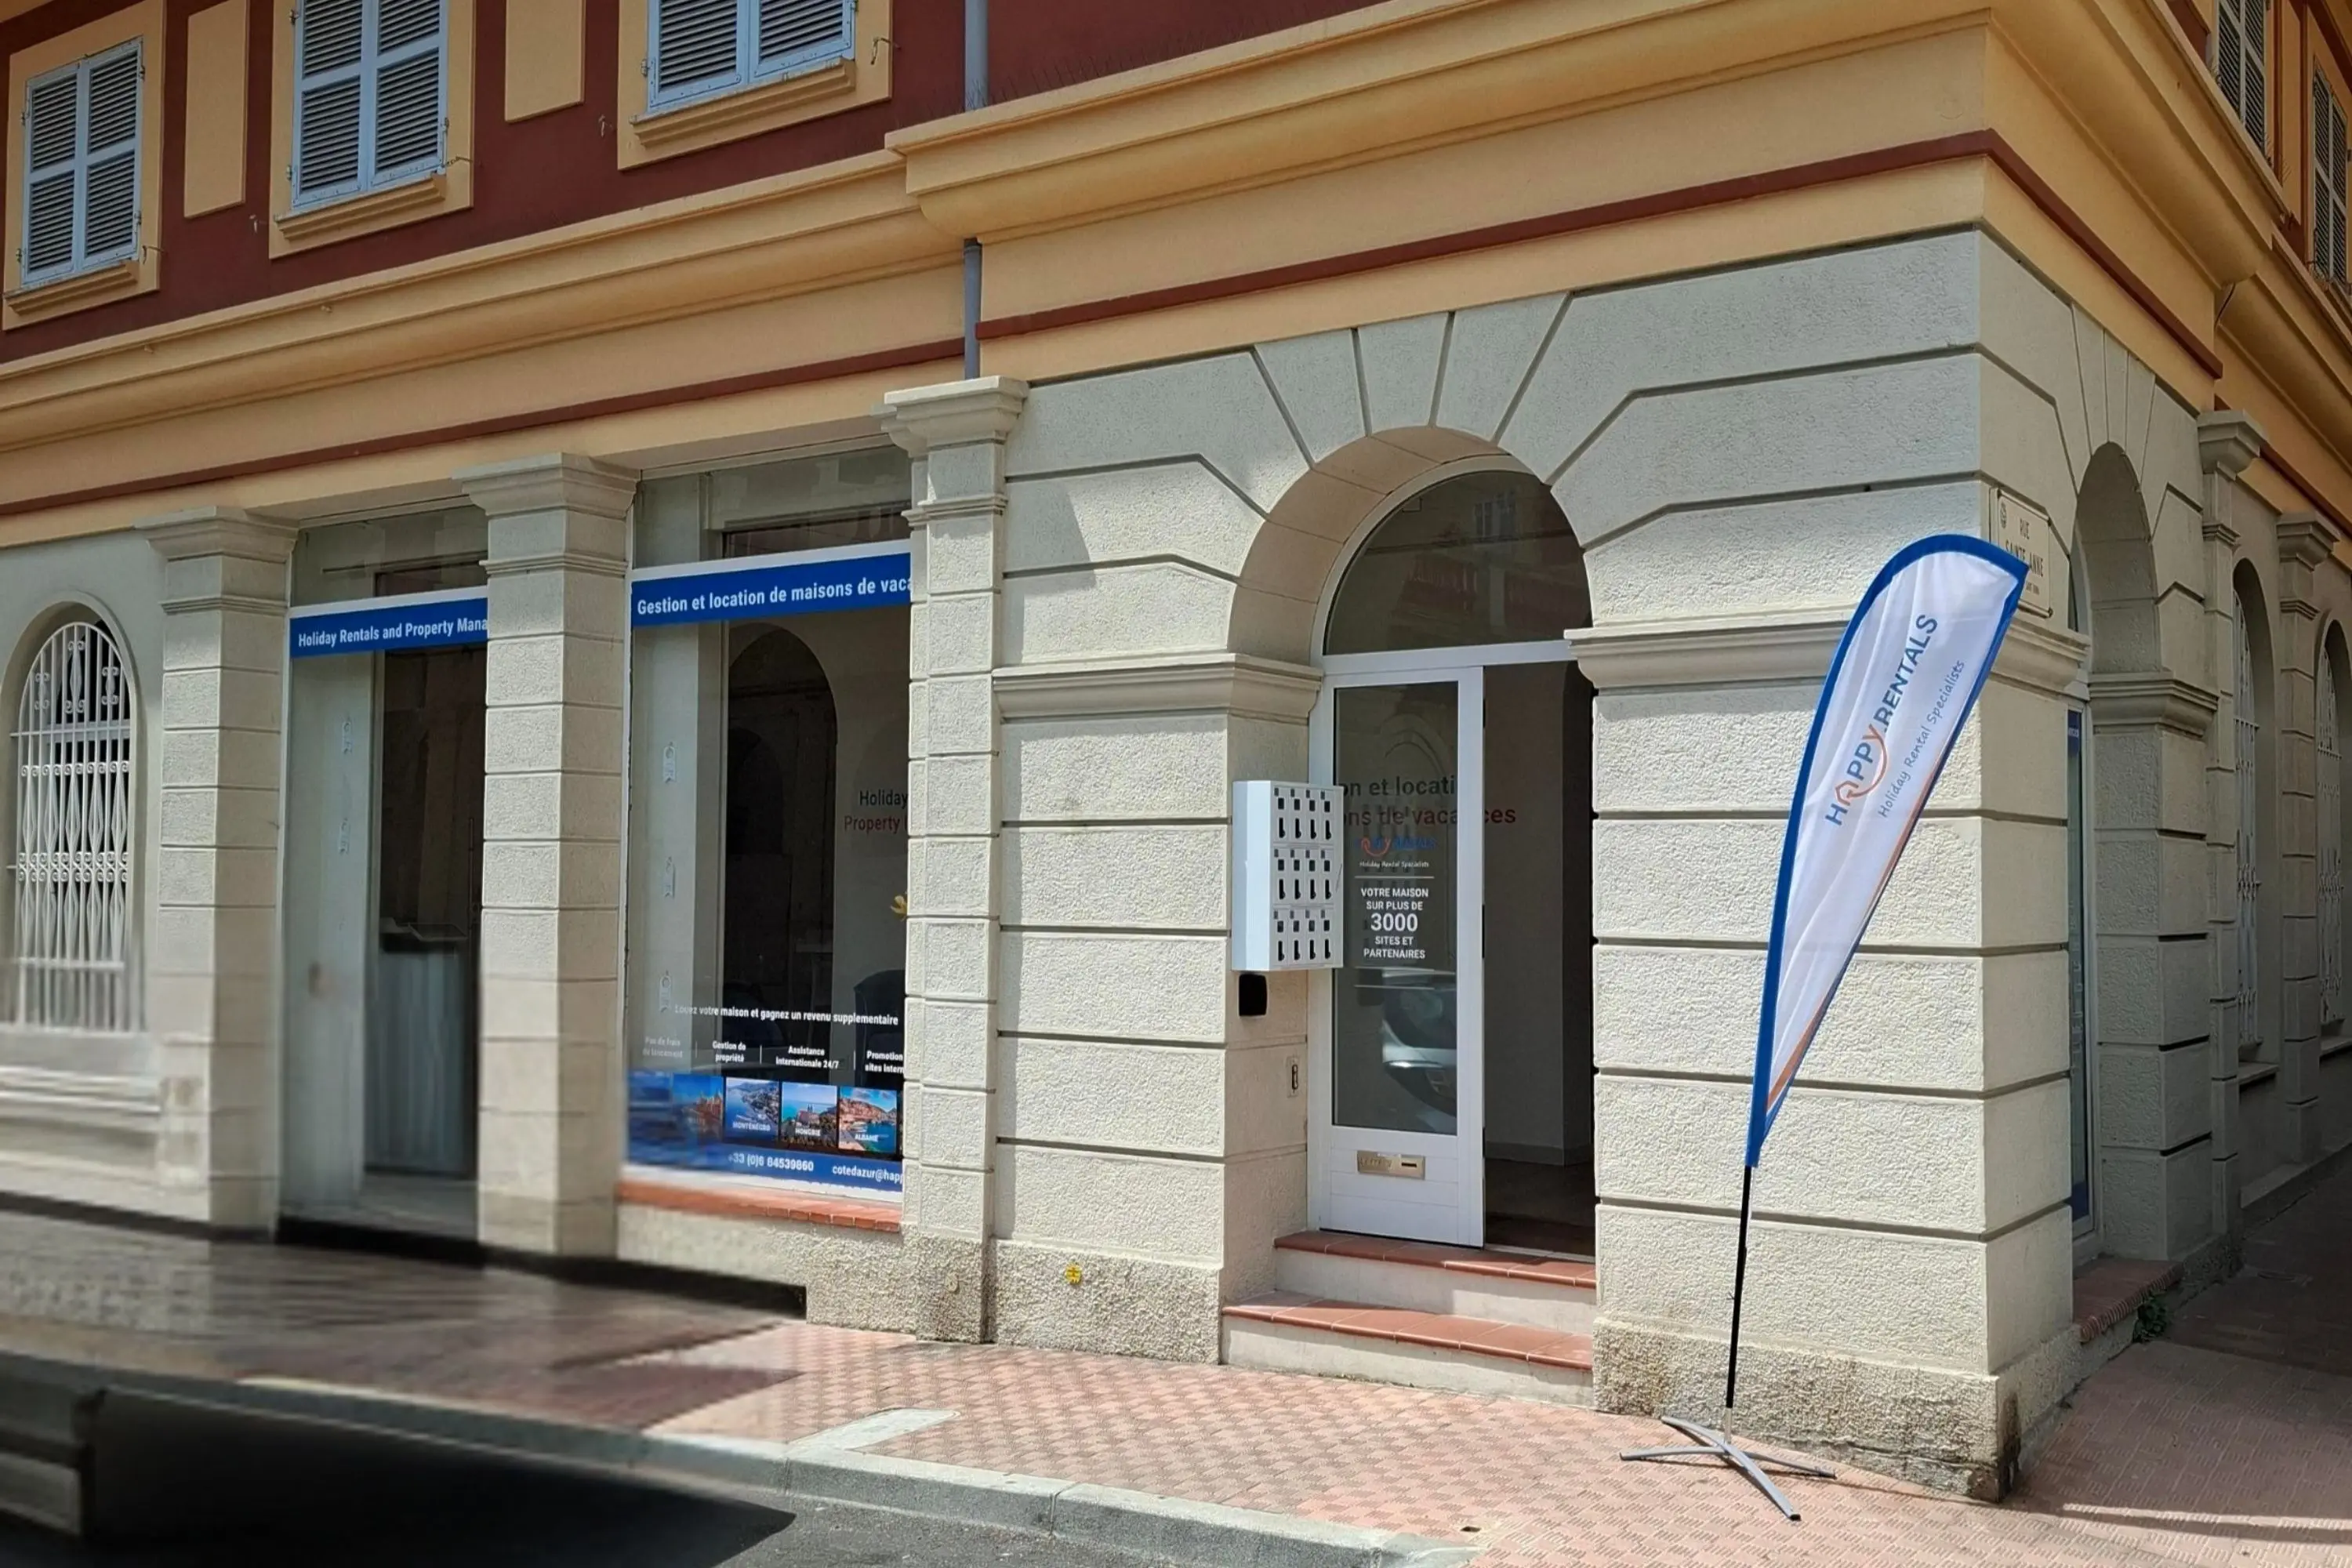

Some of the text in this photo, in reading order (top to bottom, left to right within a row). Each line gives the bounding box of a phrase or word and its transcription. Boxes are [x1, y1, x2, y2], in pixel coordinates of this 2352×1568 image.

[2020, 518, 2030, 539] RUE
[637, 597, 688, 615] Gestion
[691, 595, 705, 610] et
[710, 590, 764, 609] location
[769, 586, 787, 603] de
[791, 583, 852, 601] maisons
[858, 577, 876, 595] de
[299, 630, 336, 648] Holiday
[339, 626, 379, 643] Rentals
[383, 623, 402, 639] and
[405, 620, 453, 639] Property
[1873, 614, 1938, 733] RENTALS
[1878, 660, 1965, 818] Holiday Rental Specialists
[1369, 778, 1389, 796] et
[859, 789, 908, 809] Holiday
[844, 815, 900, 834] Property
[1360, 887, 1428, 898] VOTRE MAISON
[1367, 901, 1423, 910] SUR PLUS DE
[1370, 913, 1418, 931] 3000
[1375, 936, 1414, 946] SITES ET
[1363, 948, 1425, 959] PARTENAIRES
[699, 1006, 719, 1016] votre
[720, 1005, 749, 1017] maison
[750, 1007, 759, 1018] et
[760, 1010, 789, 1021] gagnez
[791, 1011, 801, 1020] un
[803, 1012, 831, 1022] revenu
[713, 1040, 746, 1051] Gestion de
[788, 1045, 825, 1056] Assistance
[715, 1053, 745, 1063] propriété
[866, 1051, 903, 1061] Promotion
[823, 1061, 839, 1069] 24/7
[865, 1063, 882, 1072] sites
[747, 1154, 764, 1167] (0)6
